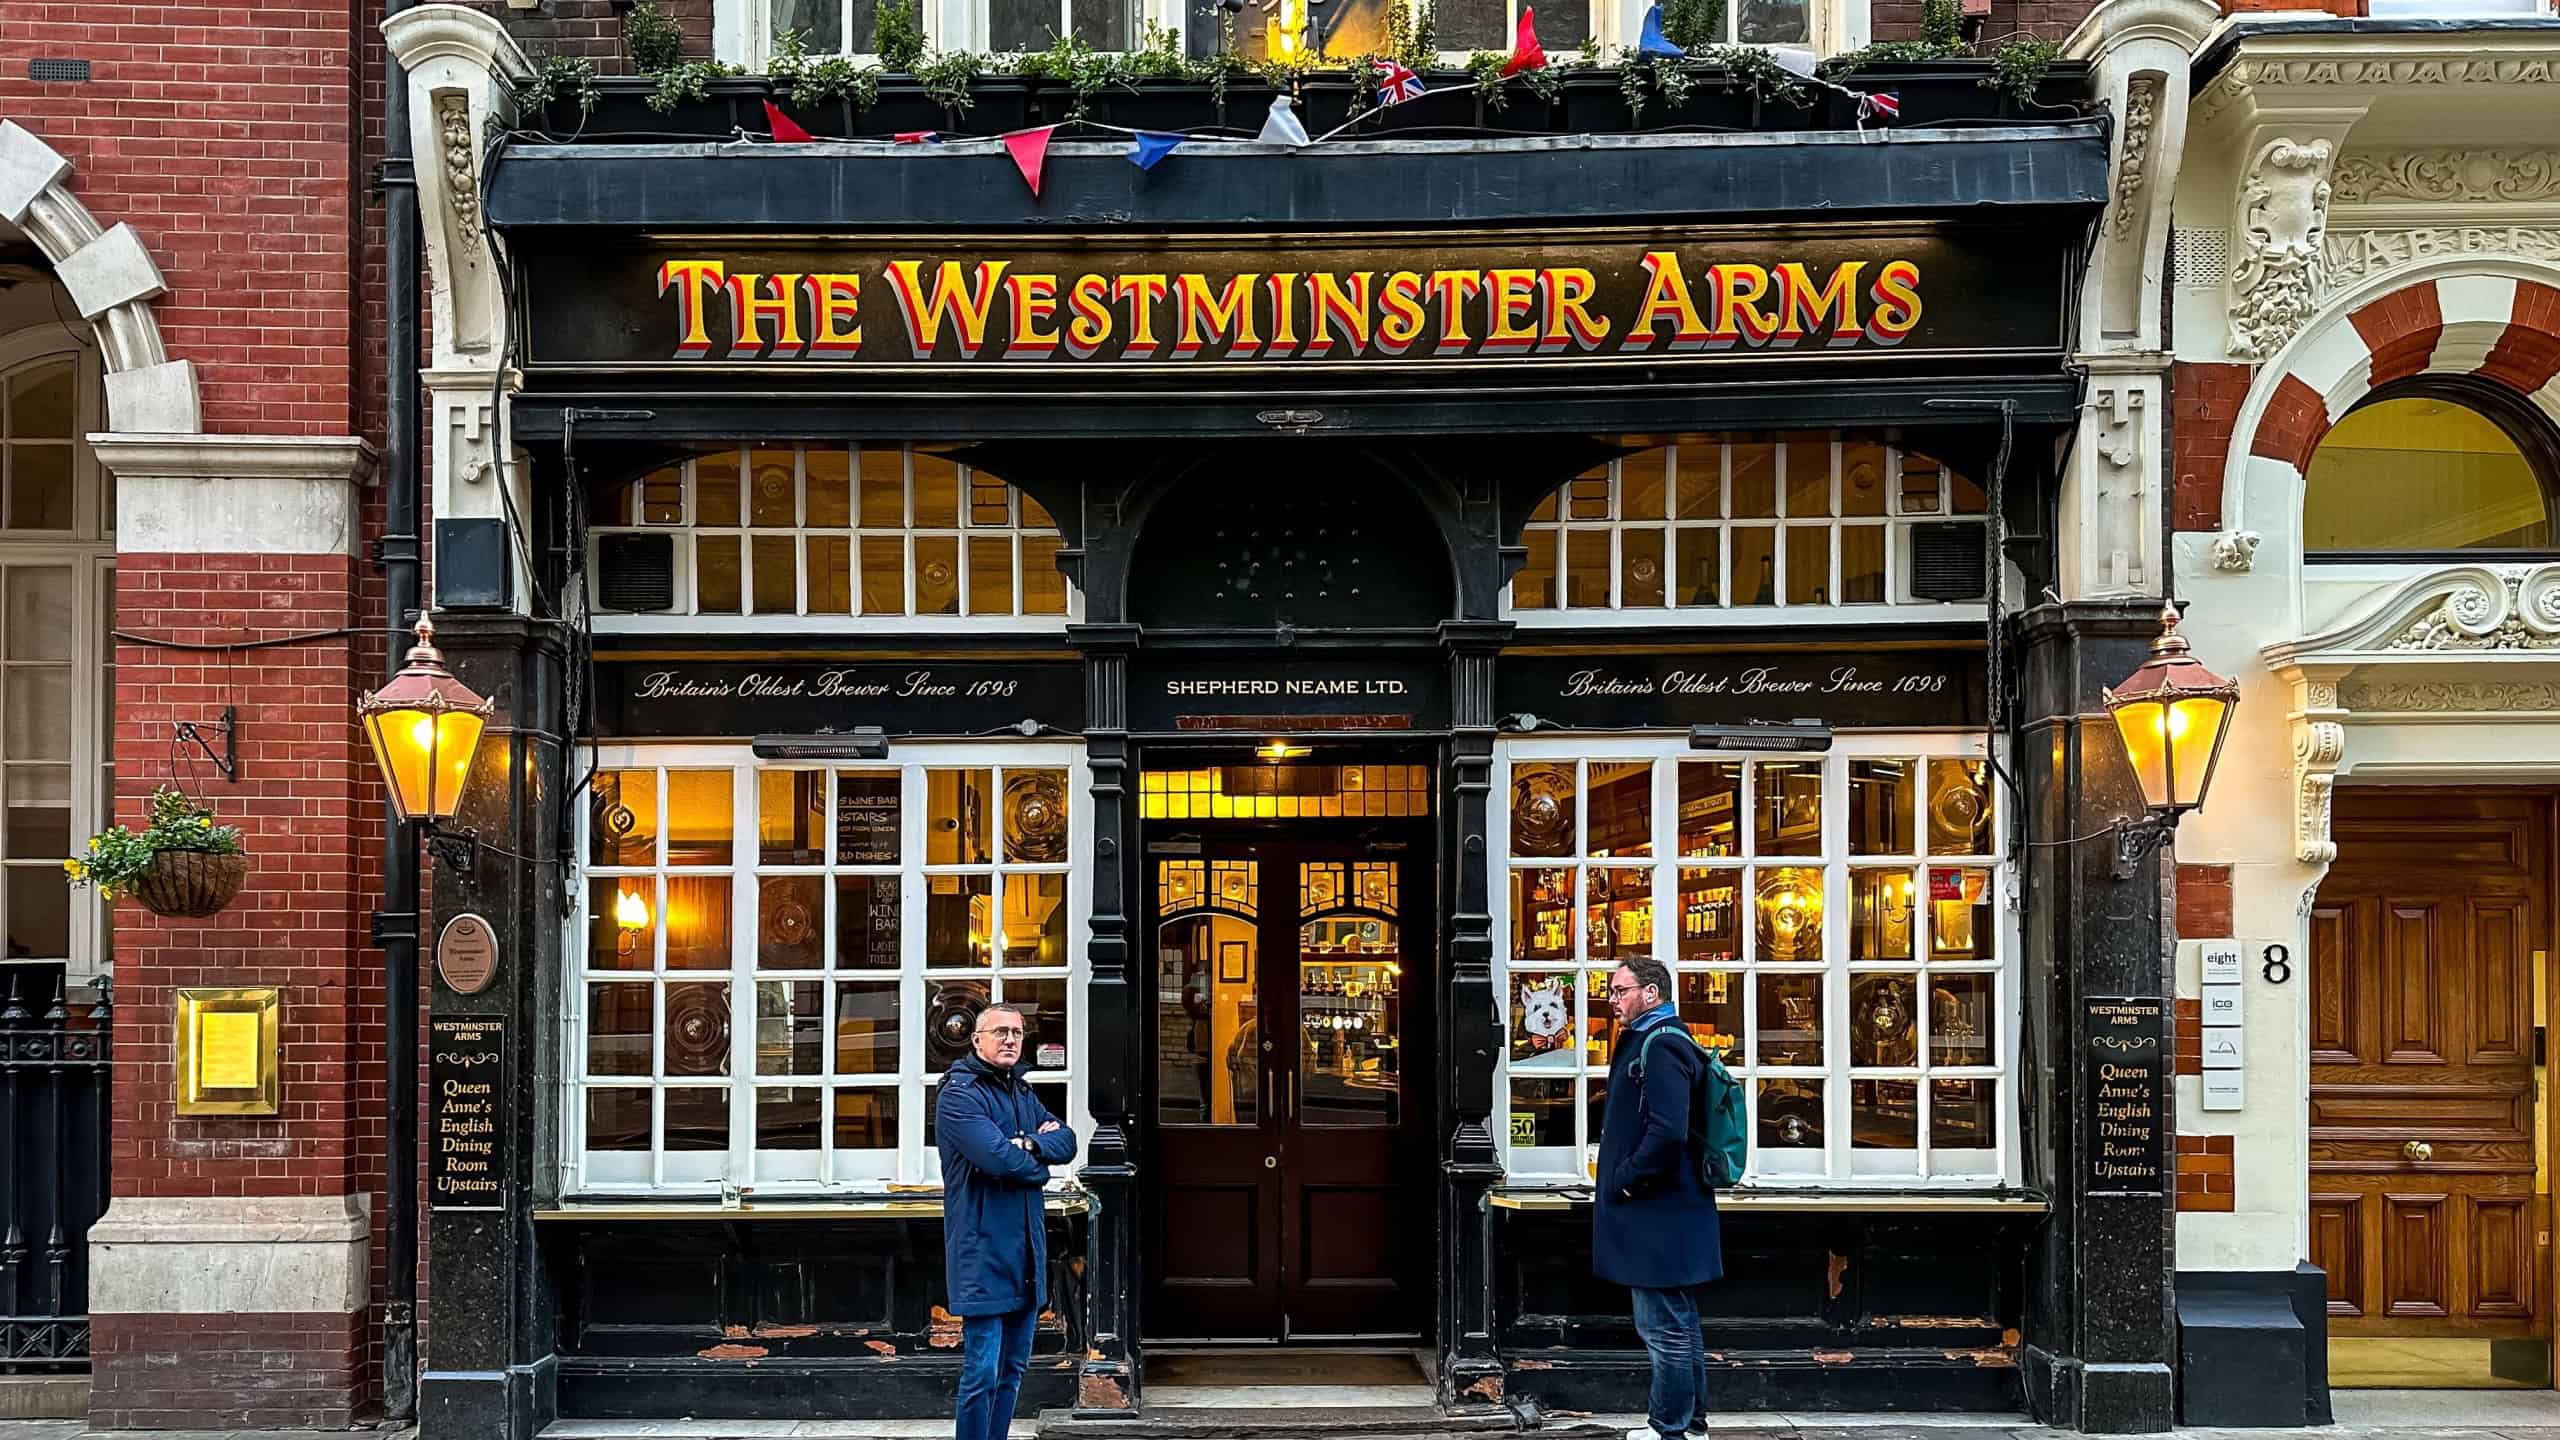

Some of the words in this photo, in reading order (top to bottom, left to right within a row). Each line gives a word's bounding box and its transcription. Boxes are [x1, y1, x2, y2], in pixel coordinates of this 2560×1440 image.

[657, 260, 863, 359] THE
[882, 260, 1610, 359] WESTMINSTER
[1619, 251, 1924, 350] ARMS
[634, 670, 735, 698] Britain's
[737, 674, 803, 696] Oldest
[807, 669, 889, 697] Brewer
[896, 671, 956, 697] Since
[964, 680, 1019, 697] 1698
[1167, 681, 1279, 695] SHEPHERD
[1285, 680, 1360, 694] NEAME
[1365, 680, 1409, 694] LTD.
[1560, 668, 1655, 697] Britain's
[1661, 671, 1728, 694] Oldest
[1731, 666, 1813, 695] Brewer
[1821, 667, 1882, 693] Since
[1891, 675, 1948, 693] 1698
[2207, 951, 2237, 966] eight
[2262, 944, 2291, 984] 8
[2089, 1006, 2159, 1015] WESTMINSTER
[433, 1022, 503, 1031] WESTMINSTER
[2110, 1016, 2138, 1025] ARMS
[454, 1032, 482, 1041] ARMS
[2100, 1063, 2148, 1081] Queen
[443, 1079, 491, 1097] Queen
[2099, 1083, 2150, 1098] Anne's
[441, 1099, 493, 1113] Anne's
[2097, 1102, 2151, 1121] English
[440, 1118, 494, 1136] English
[2100, 1122, 2151, 1141] Dining
[441, 1137, 494, 1155] Dining
[446, 1157, 489, 1172] Room
[2095, 1161, 2156, 1179] Upstairs
[437, 1176, 499, 1194] Upstairs
